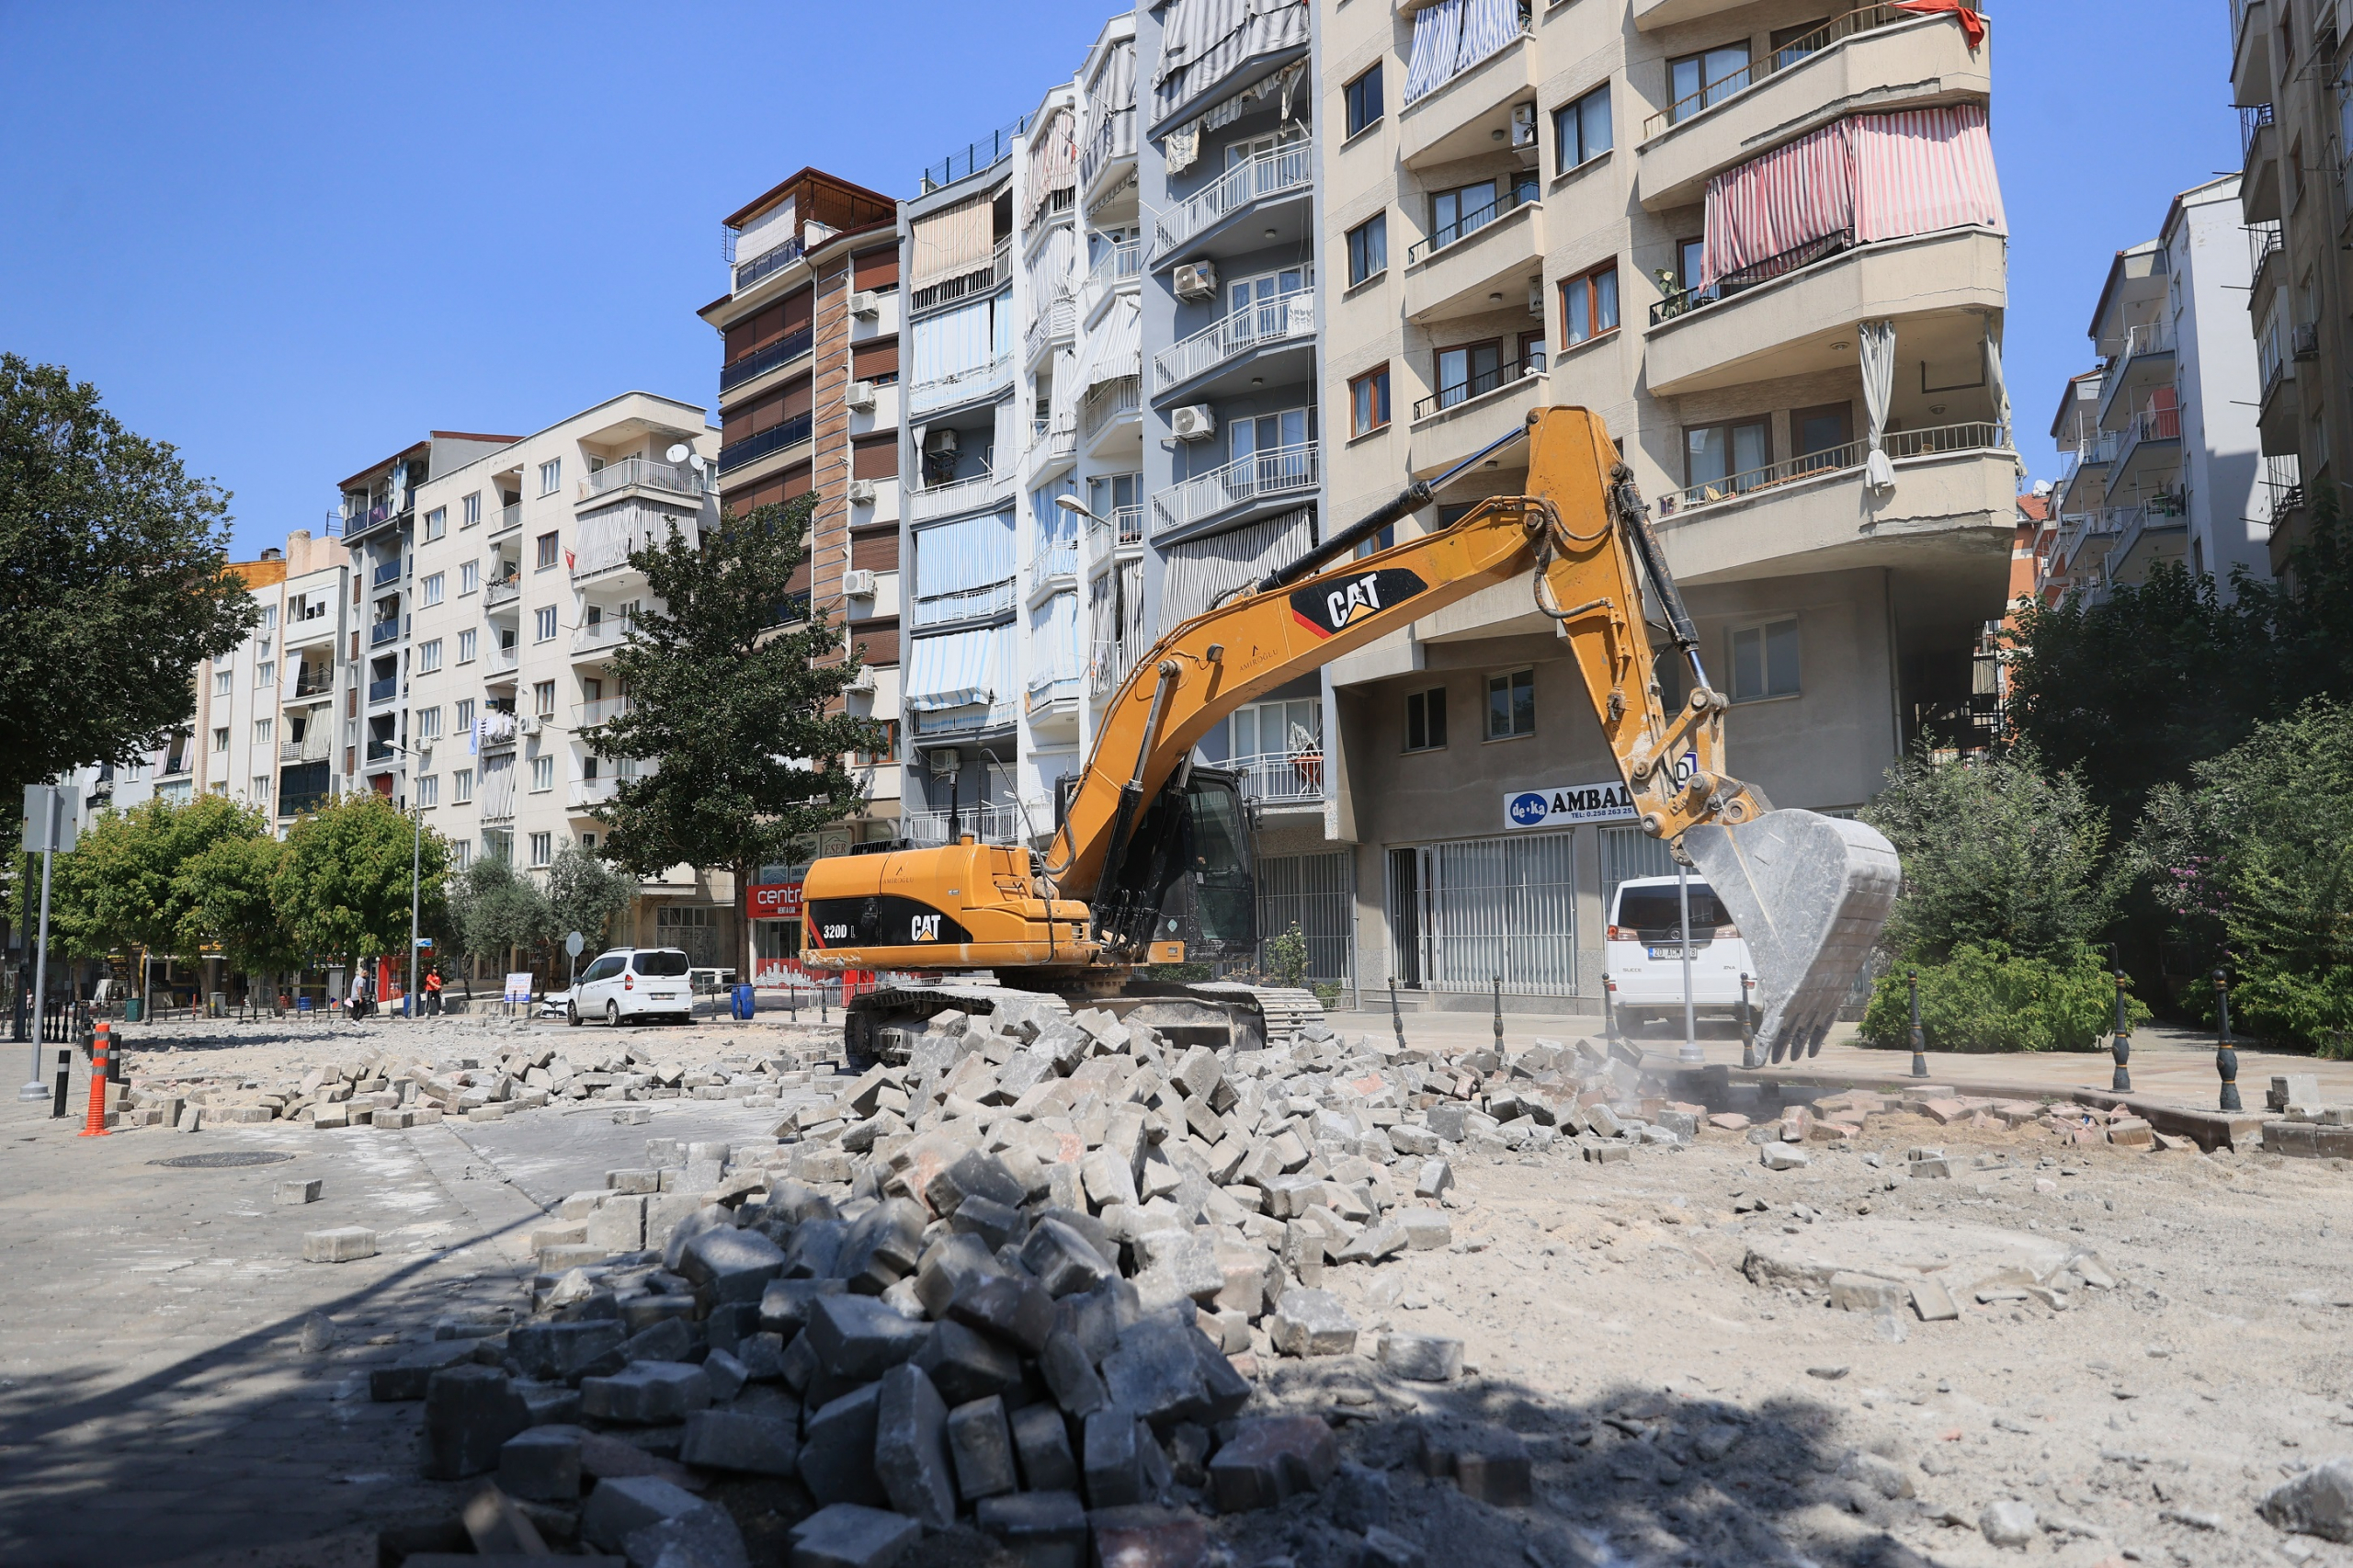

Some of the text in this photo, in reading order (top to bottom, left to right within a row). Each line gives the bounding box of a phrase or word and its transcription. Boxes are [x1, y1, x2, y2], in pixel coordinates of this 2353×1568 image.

[1327, 573, 1381, 628] CAT
[1586, 810, 1607, 818] 0.258
[824, 843, 847, 856] ESER
[823, 924, 847, 938] 320D
[911, 915, 941, 942] CAT
[1654, 948, 1664, 957] 20
